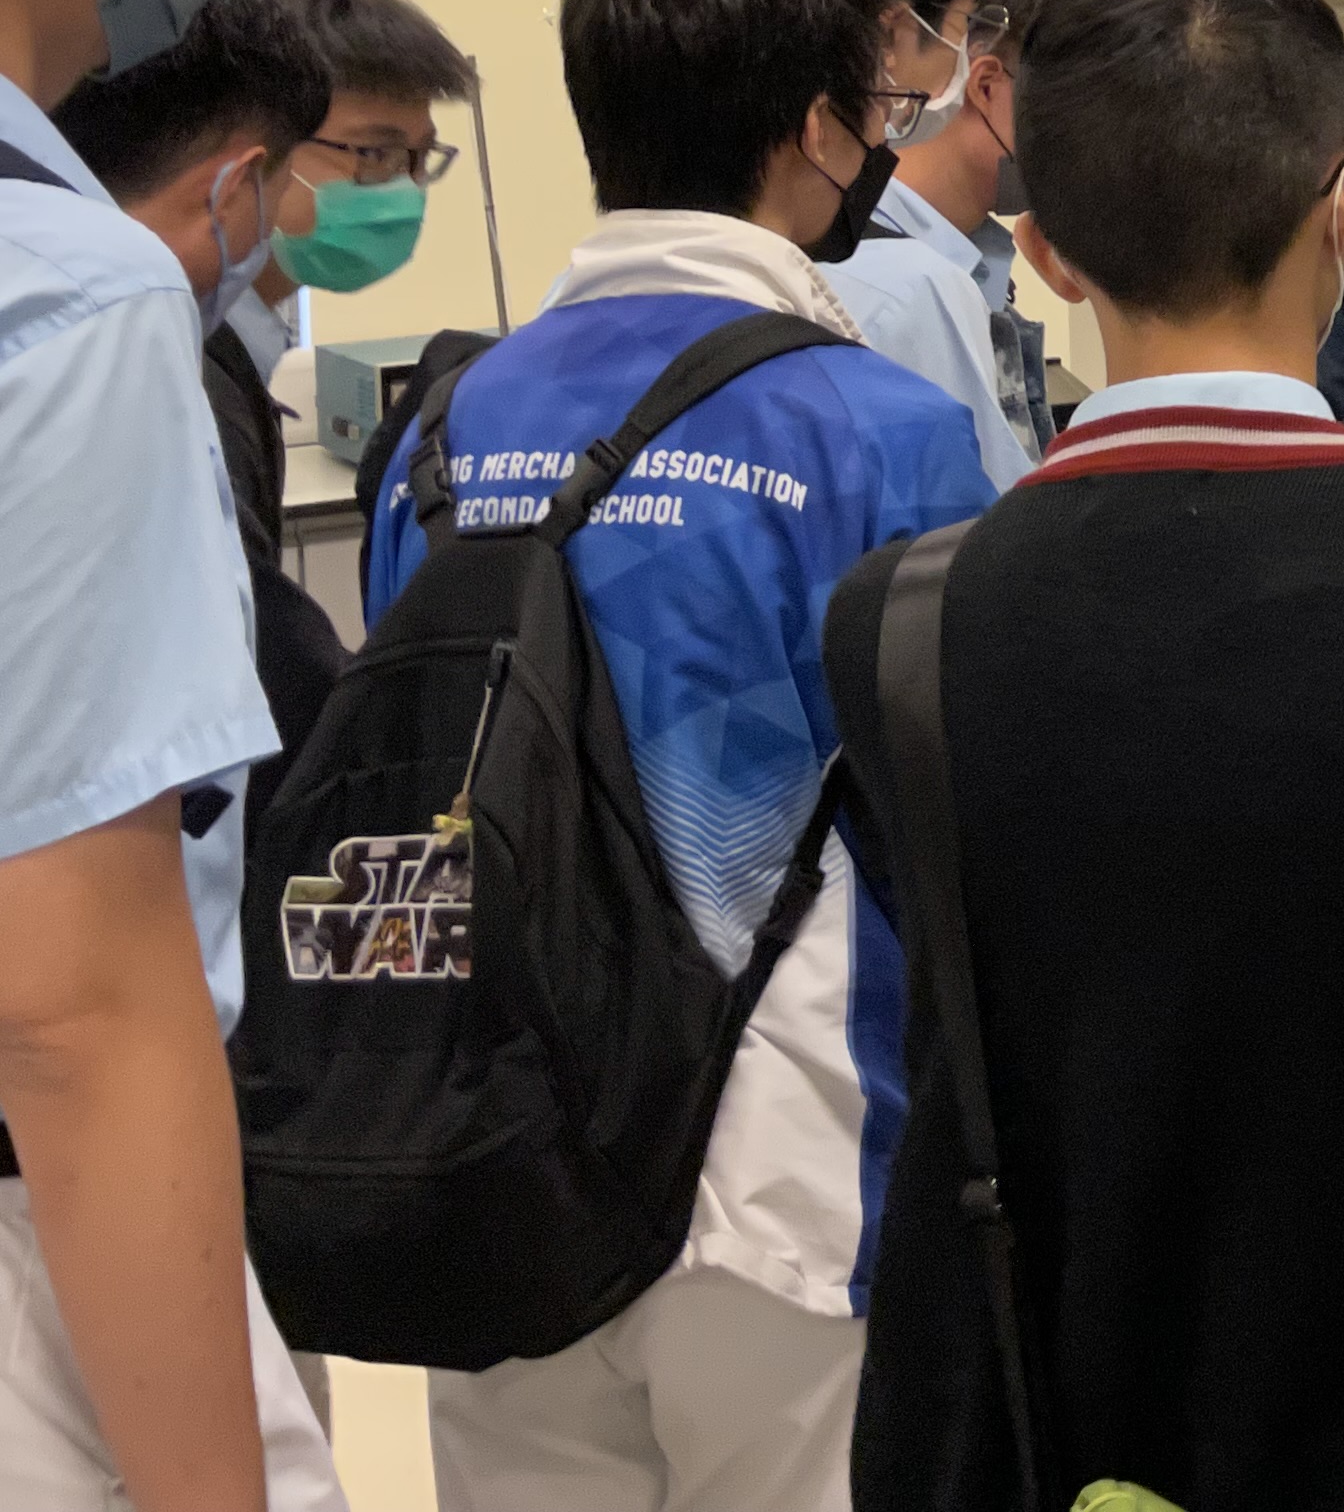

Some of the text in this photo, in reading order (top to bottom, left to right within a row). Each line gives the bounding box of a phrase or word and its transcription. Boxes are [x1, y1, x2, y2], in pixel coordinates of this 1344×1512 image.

[480, 451, 576, 481] MERCHA
[630, 449, 808, 511] ASSOCIATION
[456, 494, 684, 528] ECONDA SCHOOL
